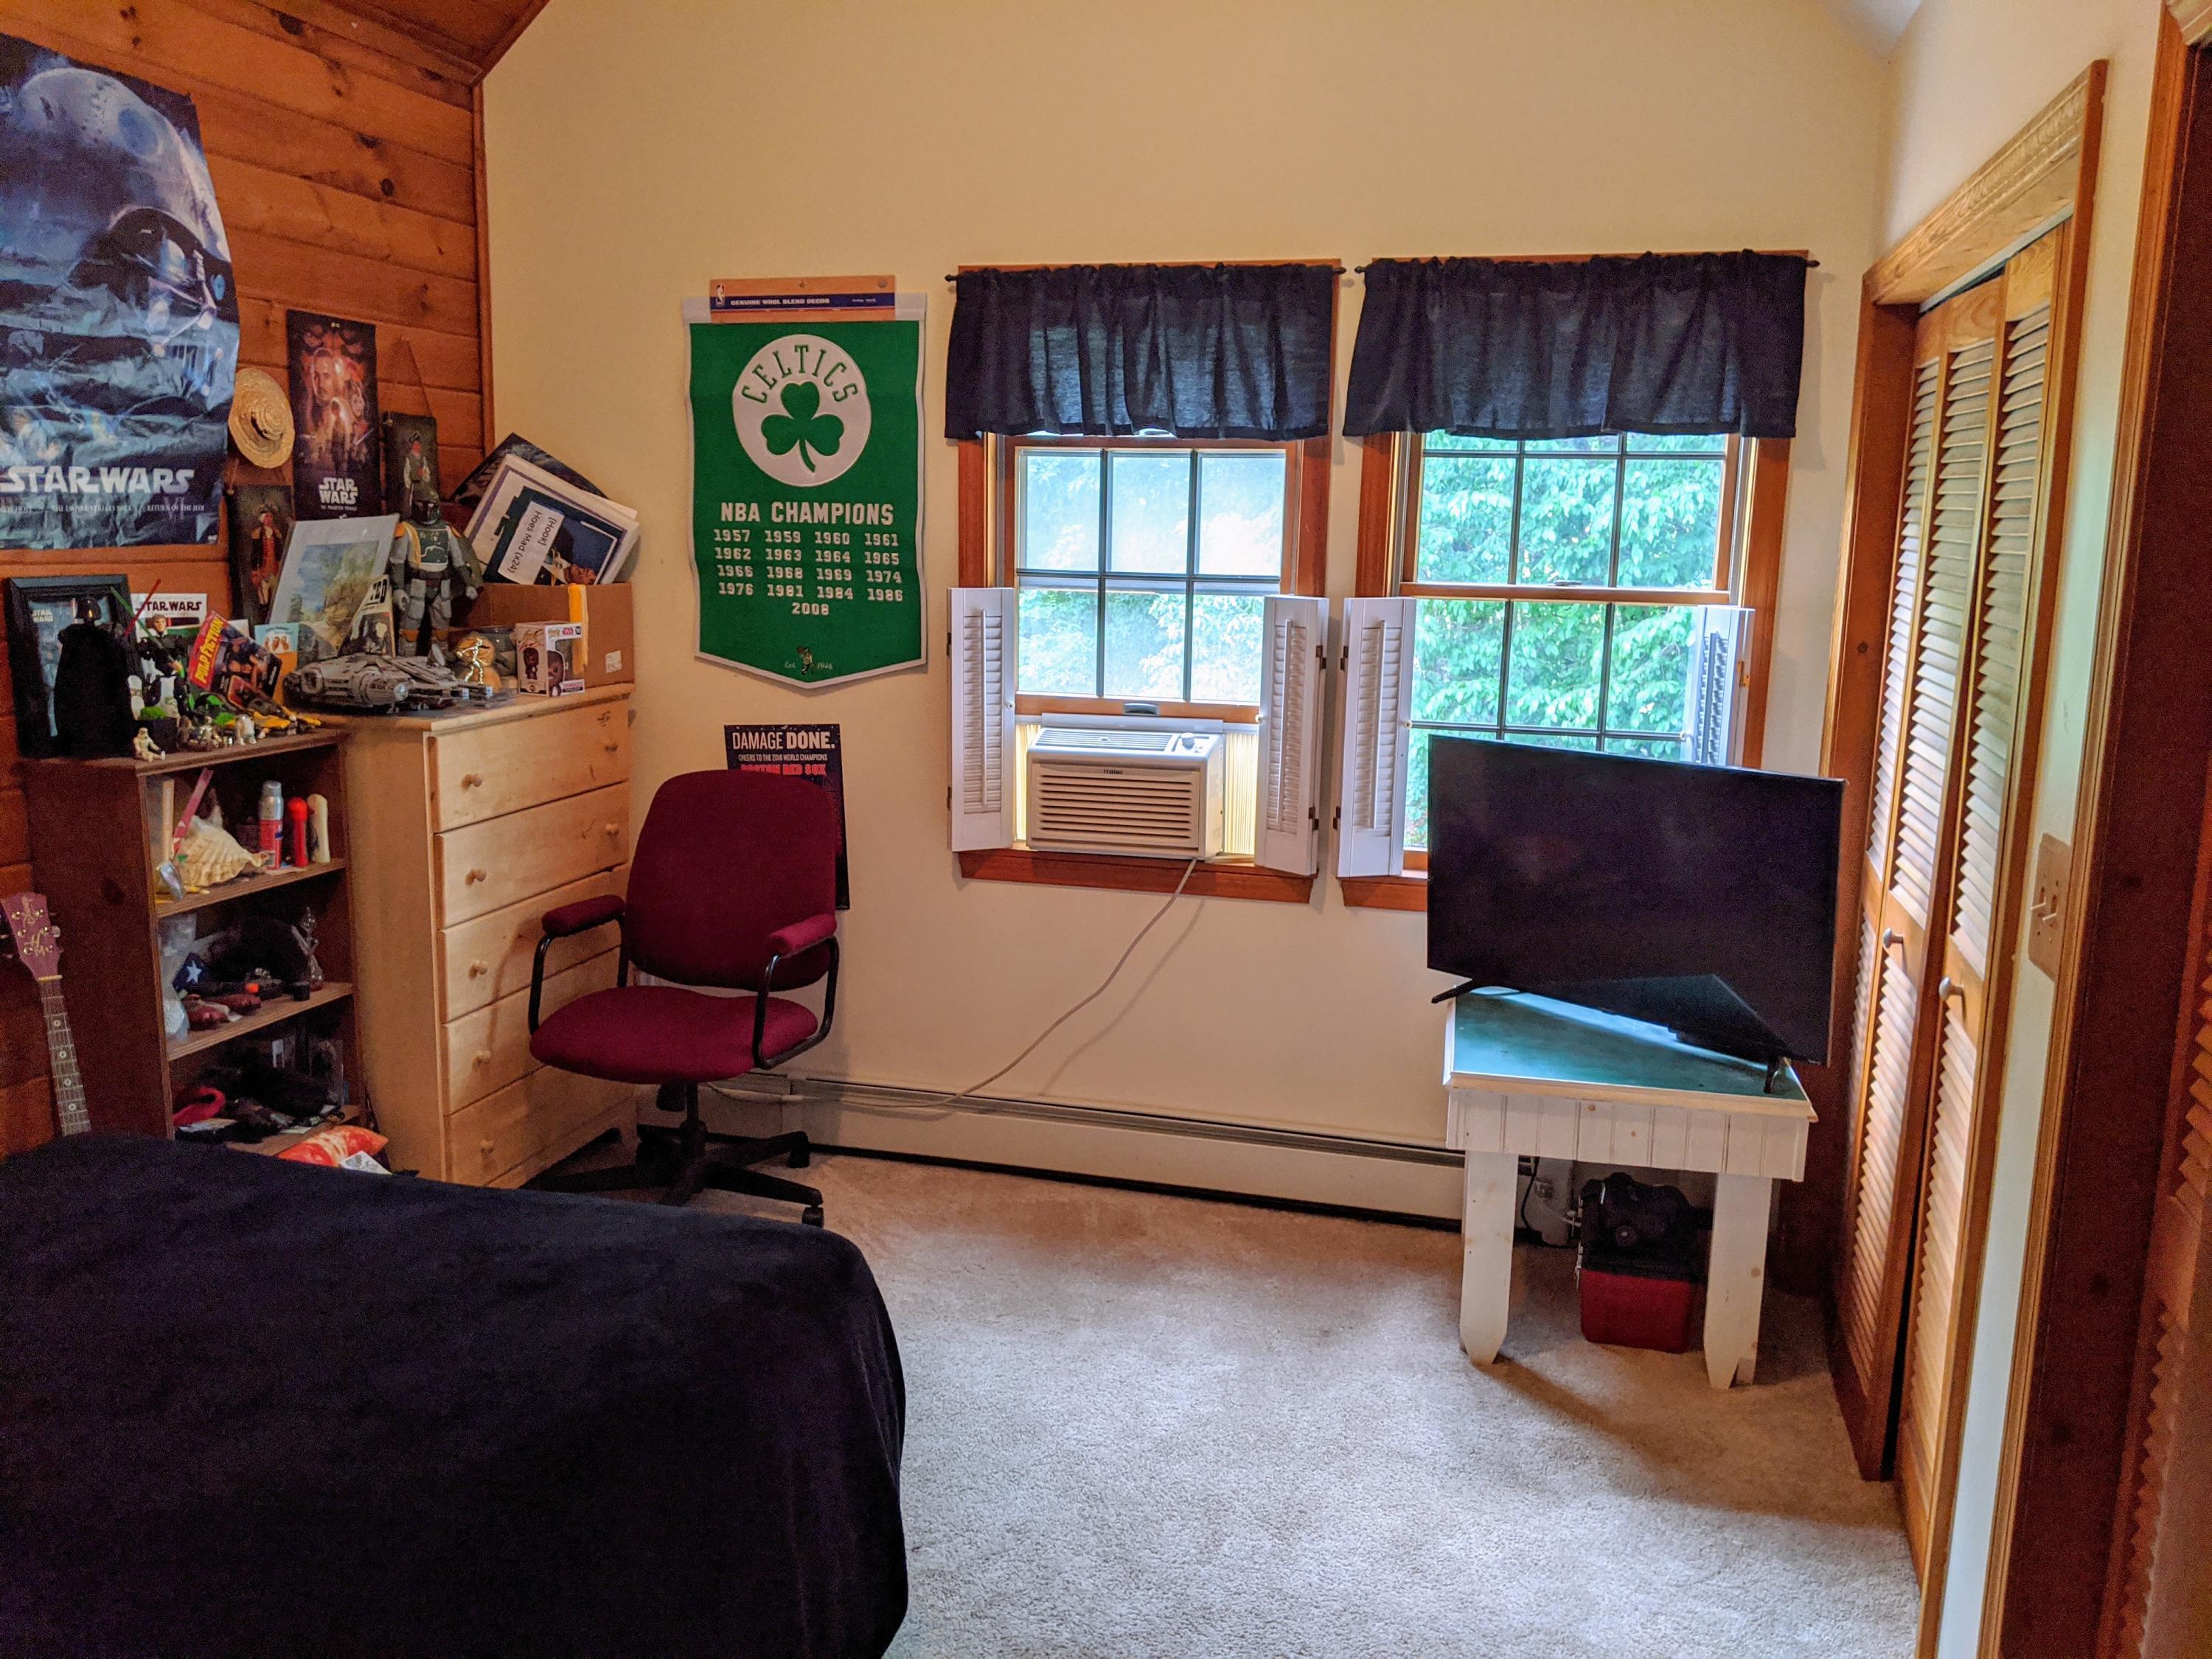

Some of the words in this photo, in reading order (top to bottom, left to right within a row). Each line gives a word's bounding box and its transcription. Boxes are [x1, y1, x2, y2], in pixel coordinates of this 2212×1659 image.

[741, 344, 858, 404] CELTICS
[0, 465, 100, 494] STAR
[99, 467, 195, 495] WARS
[319, 477, 358, 492] STAR
[319, 490, 358, 504] WARS
[526, 510, 542, 532] Hoes
[720, 502, 761, 523] NBA
[771, 501, 894, 526] CHAMPIONS
[537, 517, 557, 546] [Hook]
[714, 529, 751, 543] 1957
[765, 530, 801, 543] 1959
[815, 531, 850, 545] 1960
[864, 532, 899, 546] 1961
[518, 533, 532, 552] Mad
[507, 552, 524, 573] (x24)
[714, 547, 751, 560] 1962
[765, 548, 802, 561] 1963
[815, 549, 851, 563] 1964
[864, 552, 900, 565] 1965
[717, 564, 754, 577] 1966
[766, 566, 803, 579] 1968
[816, 568, 852, 581] 1969
[866, 570, 902, 584] 1974
[719, 582, 754, 596] 1976
[767, 584, 804, 597] 1981
[817, 585, 854, 599] 1984
[867, 588, 903, 602] 1986
[169, 601, 202, 611] WARS
[791, 602, 830, 616] 2008
[200, 616, 224, 658] FICTION
[195, 654, 211, 684] PULP
[732, 731, 783, 750] DAMAGE
[786, 731, 835, 750] DONE.
[738, 754, 755, 762] CHEERS
[756, 754, 762, 762] TO
[763, 754, 771, 762] THE
[782, 764, 803, 775] RED
[804, 764, 826, 775] SOX
